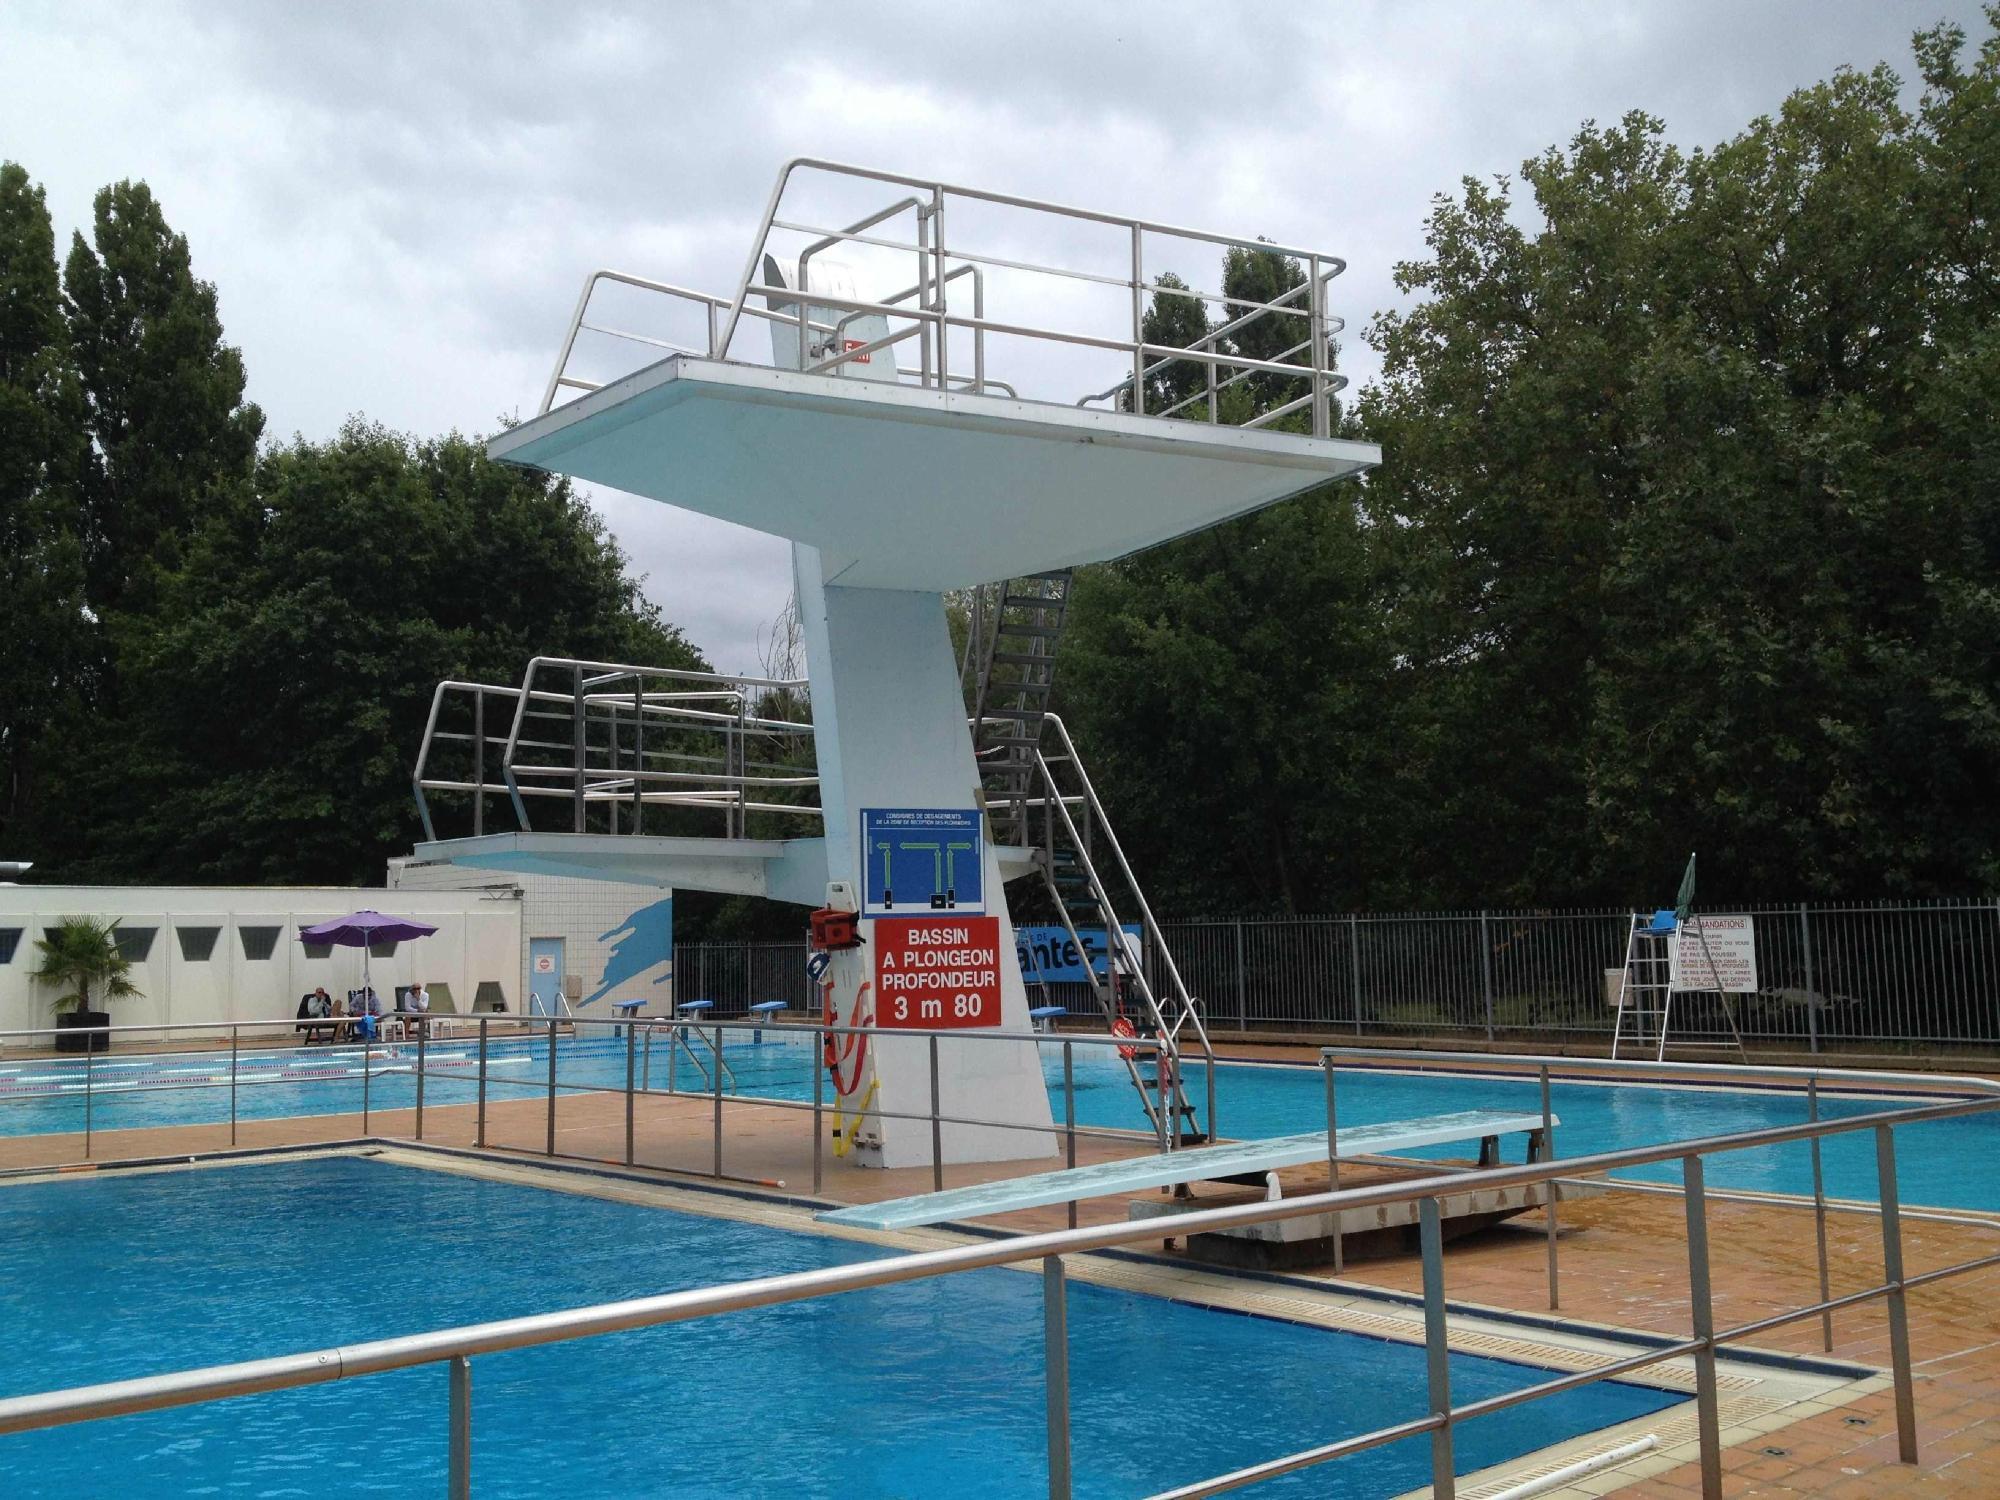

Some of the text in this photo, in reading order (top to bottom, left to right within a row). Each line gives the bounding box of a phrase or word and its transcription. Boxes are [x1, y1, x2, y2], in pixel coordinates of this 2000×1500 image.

[908, 928, 968, 945] BASSIN
[882, 949, 994, 969] A PLONGEON
[882, 970, 995, 991] PROFONDEUR
[894, 993, 982, 1020] 3 m 80
